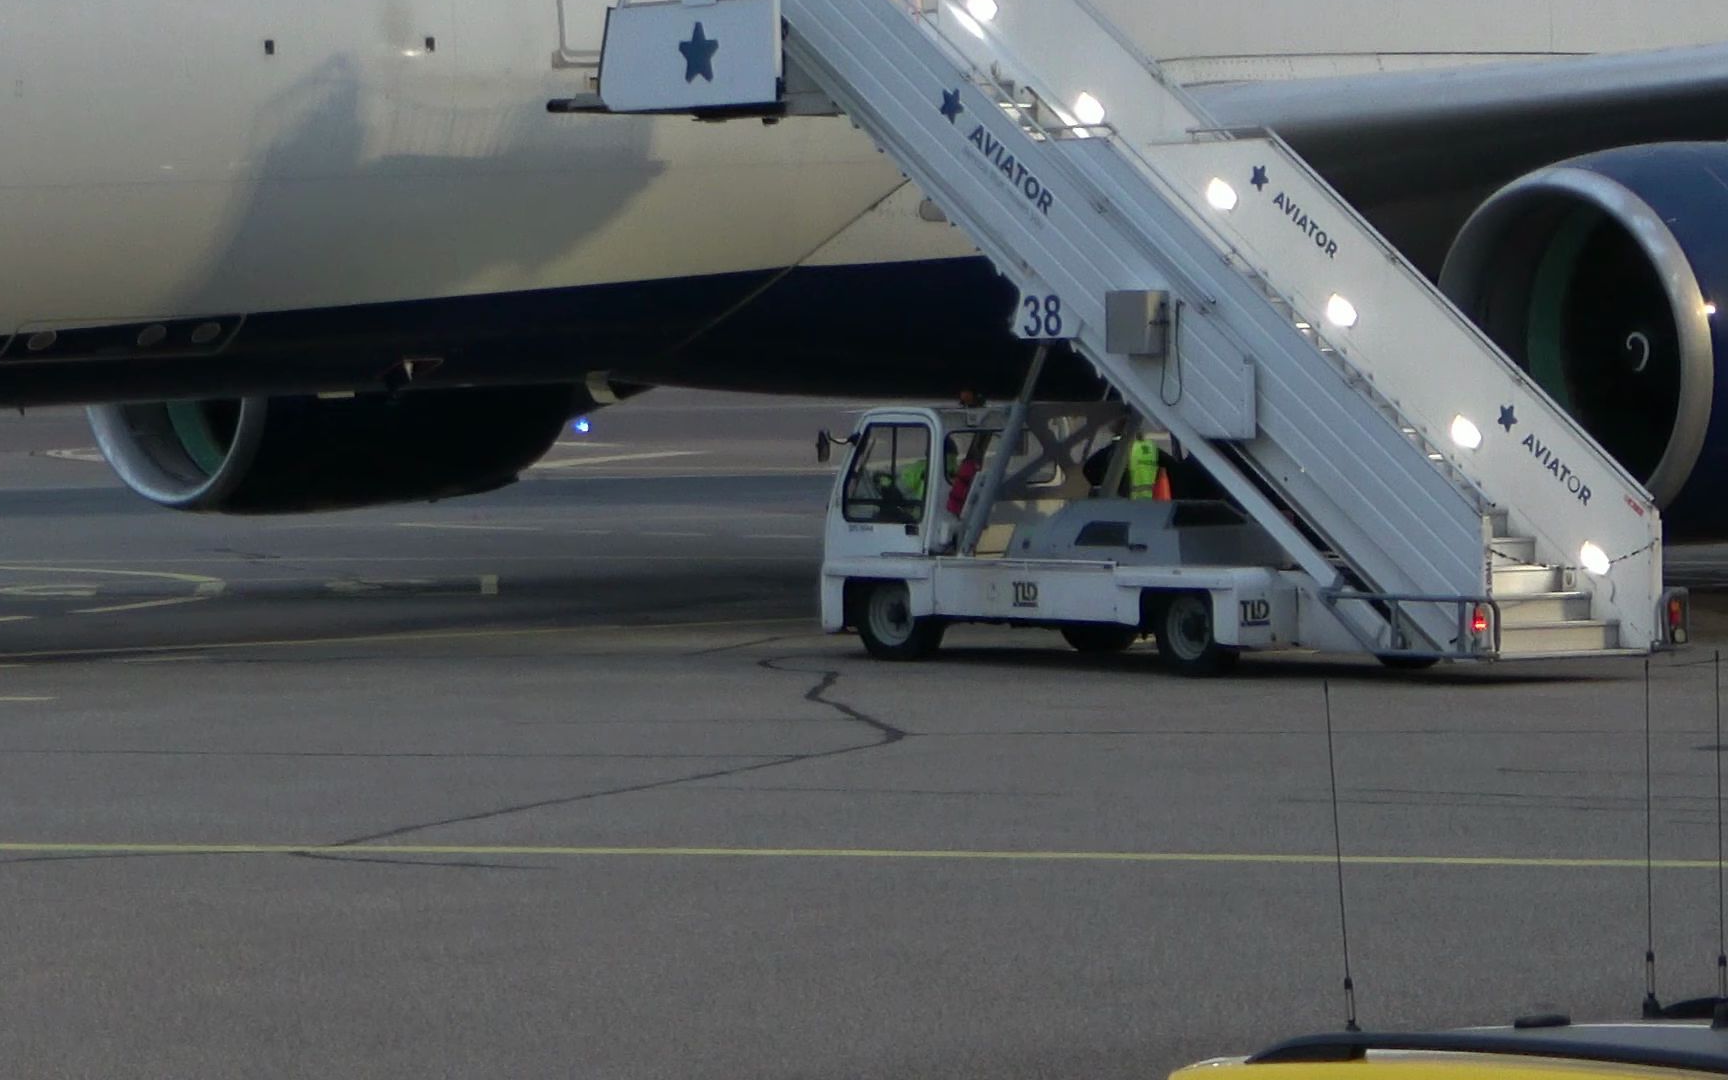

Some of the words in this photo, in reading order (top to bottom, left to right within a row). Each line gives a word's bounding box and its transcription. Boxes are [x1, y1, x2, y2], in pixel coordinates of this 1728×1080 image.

[968, 124, 1054, 216] AVIATOR
[1272, 191, 1338, 259] AVIATOR
[1023, 294, 1062, 337] 38
[1522, 433, 1592, 506] AVIATOR
[1012, 581, 1038, 602] TLD
[1239, 600, 1270, 621] TLD
